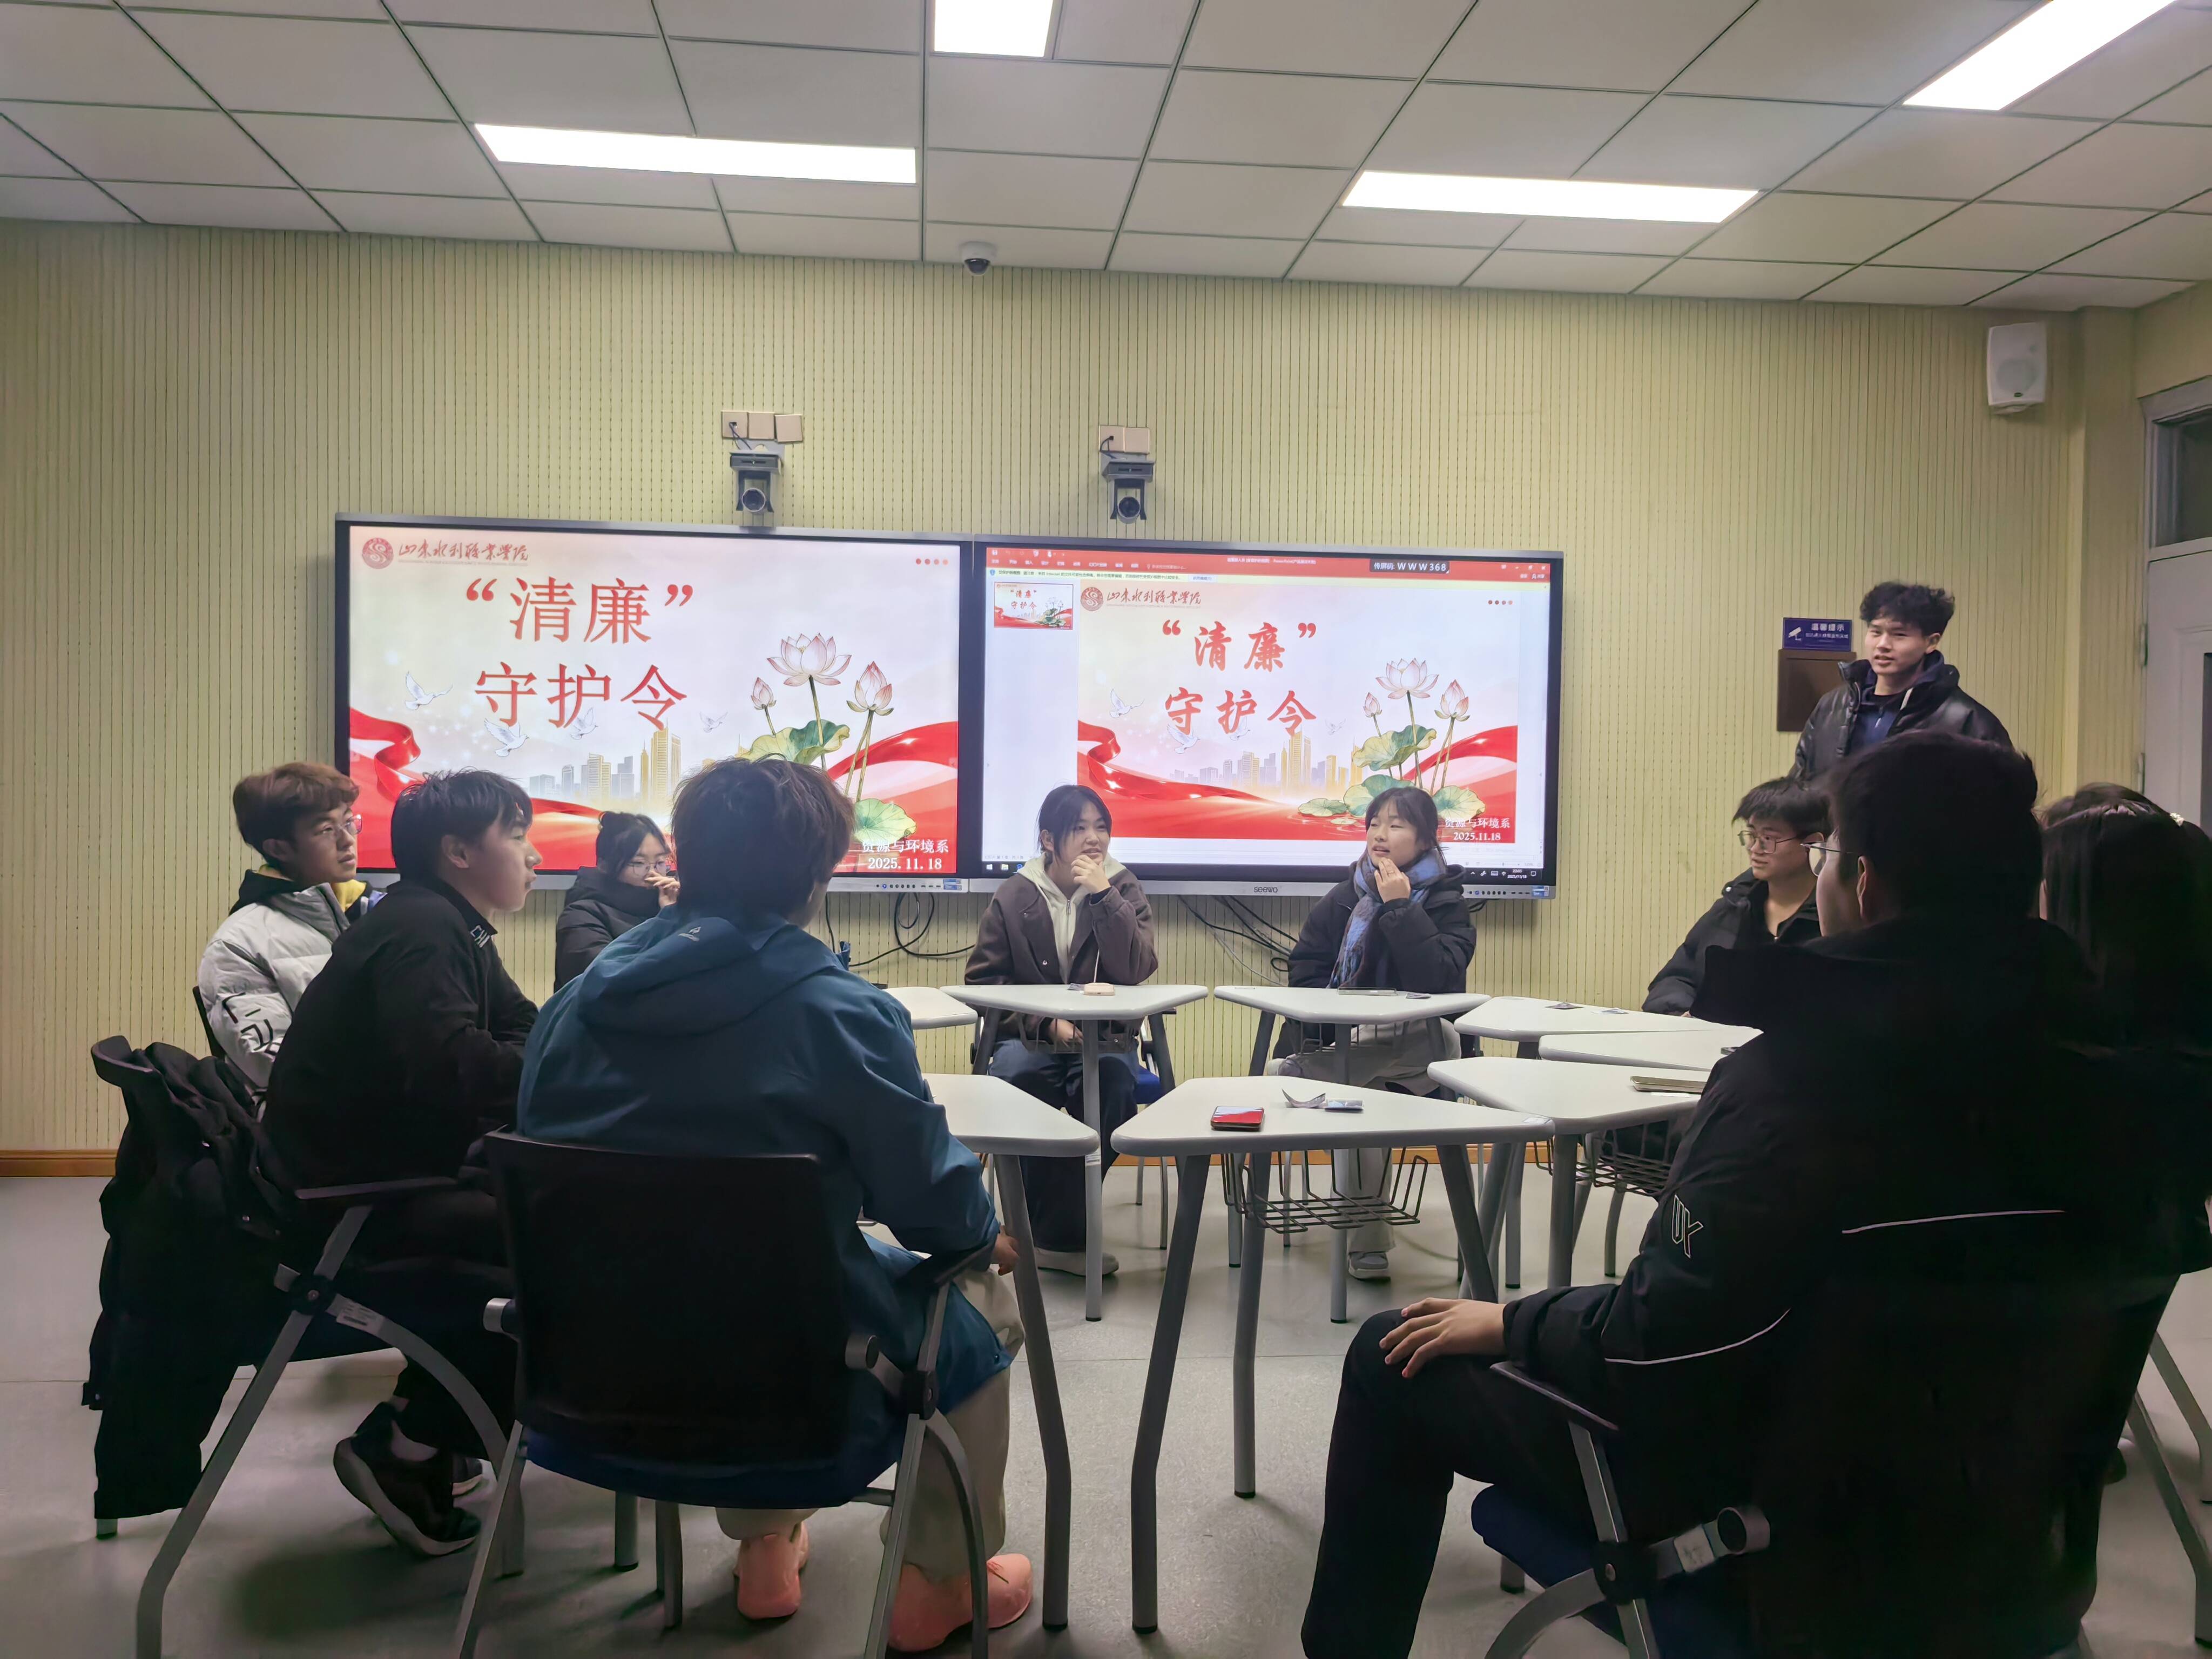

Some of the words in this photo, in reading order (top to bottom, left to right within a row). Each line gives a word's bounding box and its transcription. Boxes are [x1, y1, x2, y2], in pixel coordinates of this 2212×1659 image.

[475, 662, 687, 730] 守护令
[1165, 686, 1316, 737] 守护令
[1445, 818, 1510, 828] 资源与环境系
[1453, 832, 1501, 841] 2025.11.18
[862, 839, 949, 853] 资源与环境系
